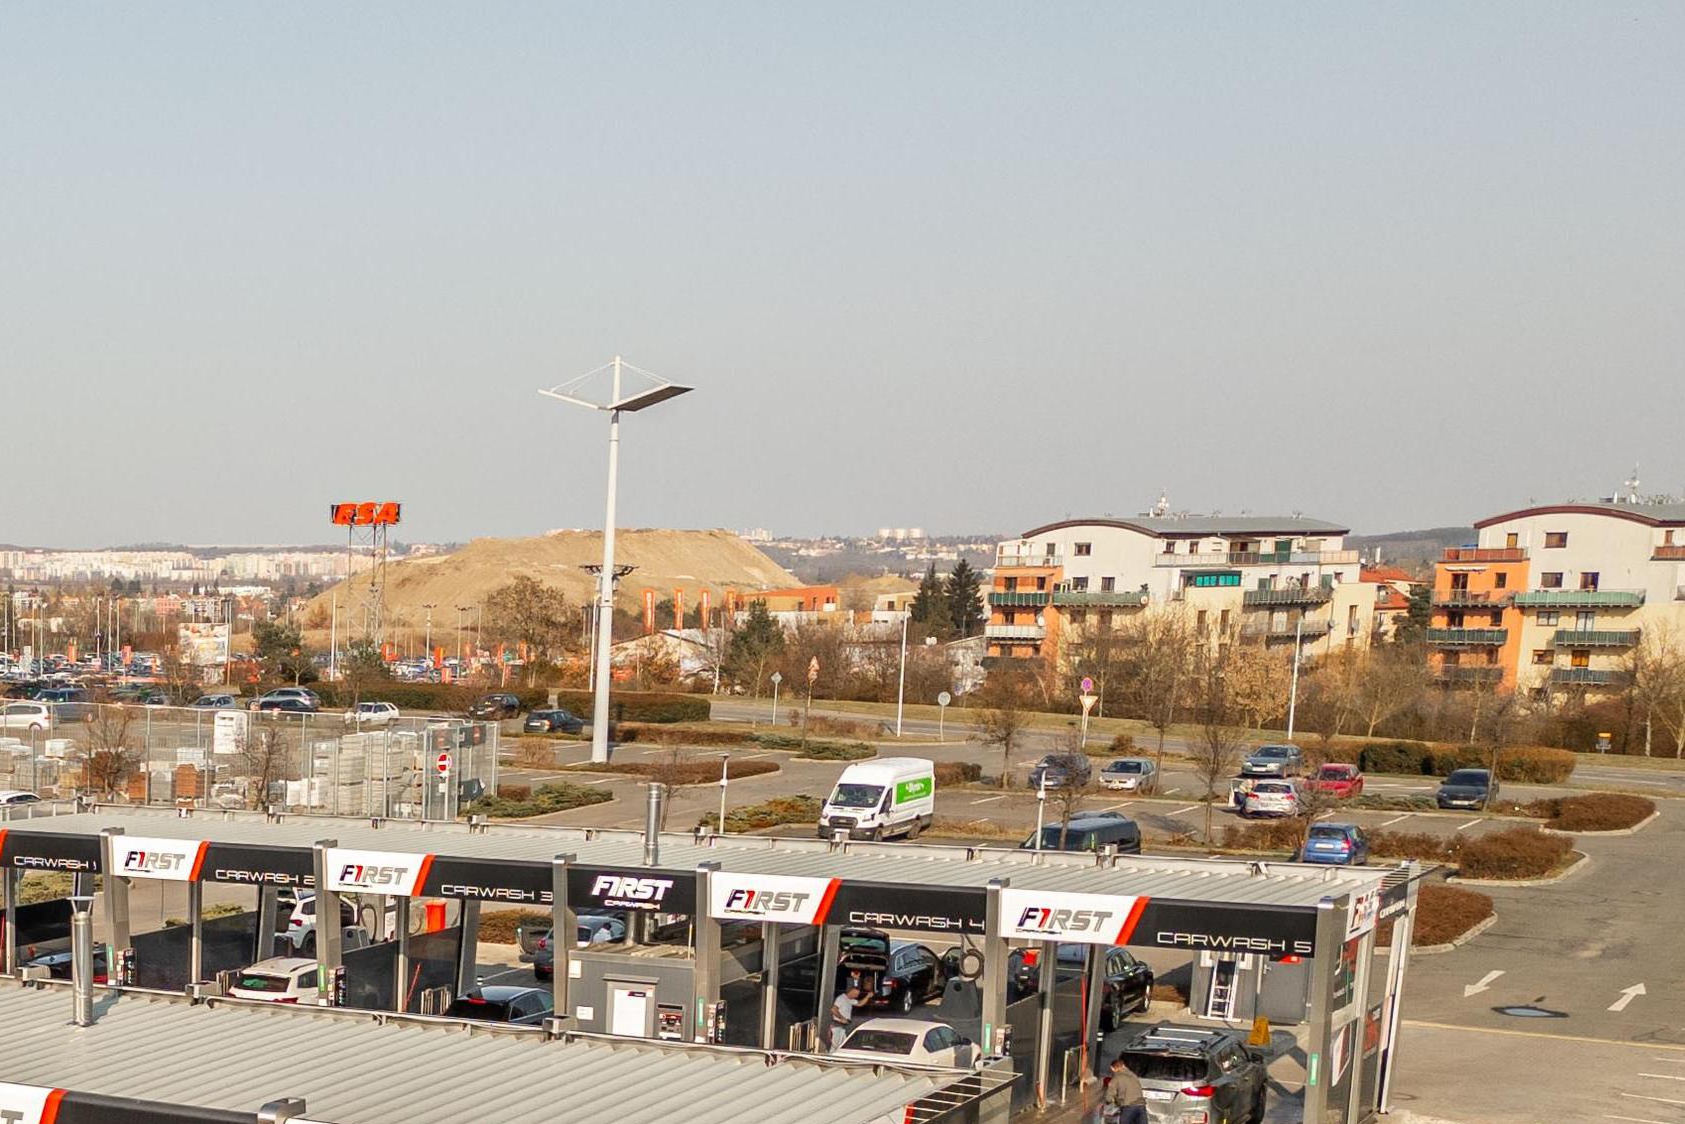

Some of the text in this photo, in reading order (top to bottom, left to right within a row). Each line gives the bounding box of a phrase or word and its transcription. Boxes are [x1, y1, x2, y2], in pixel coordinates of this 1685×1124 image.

[14, 855, 89, 870] CARWASH
[215, 869, 299, 885] CARWASH
[441, 884, 554, 902] CARWASH 3
[849, 911, 985, 931] CARWASH 4
[1156, 931, 1286, 951] CARWASH
